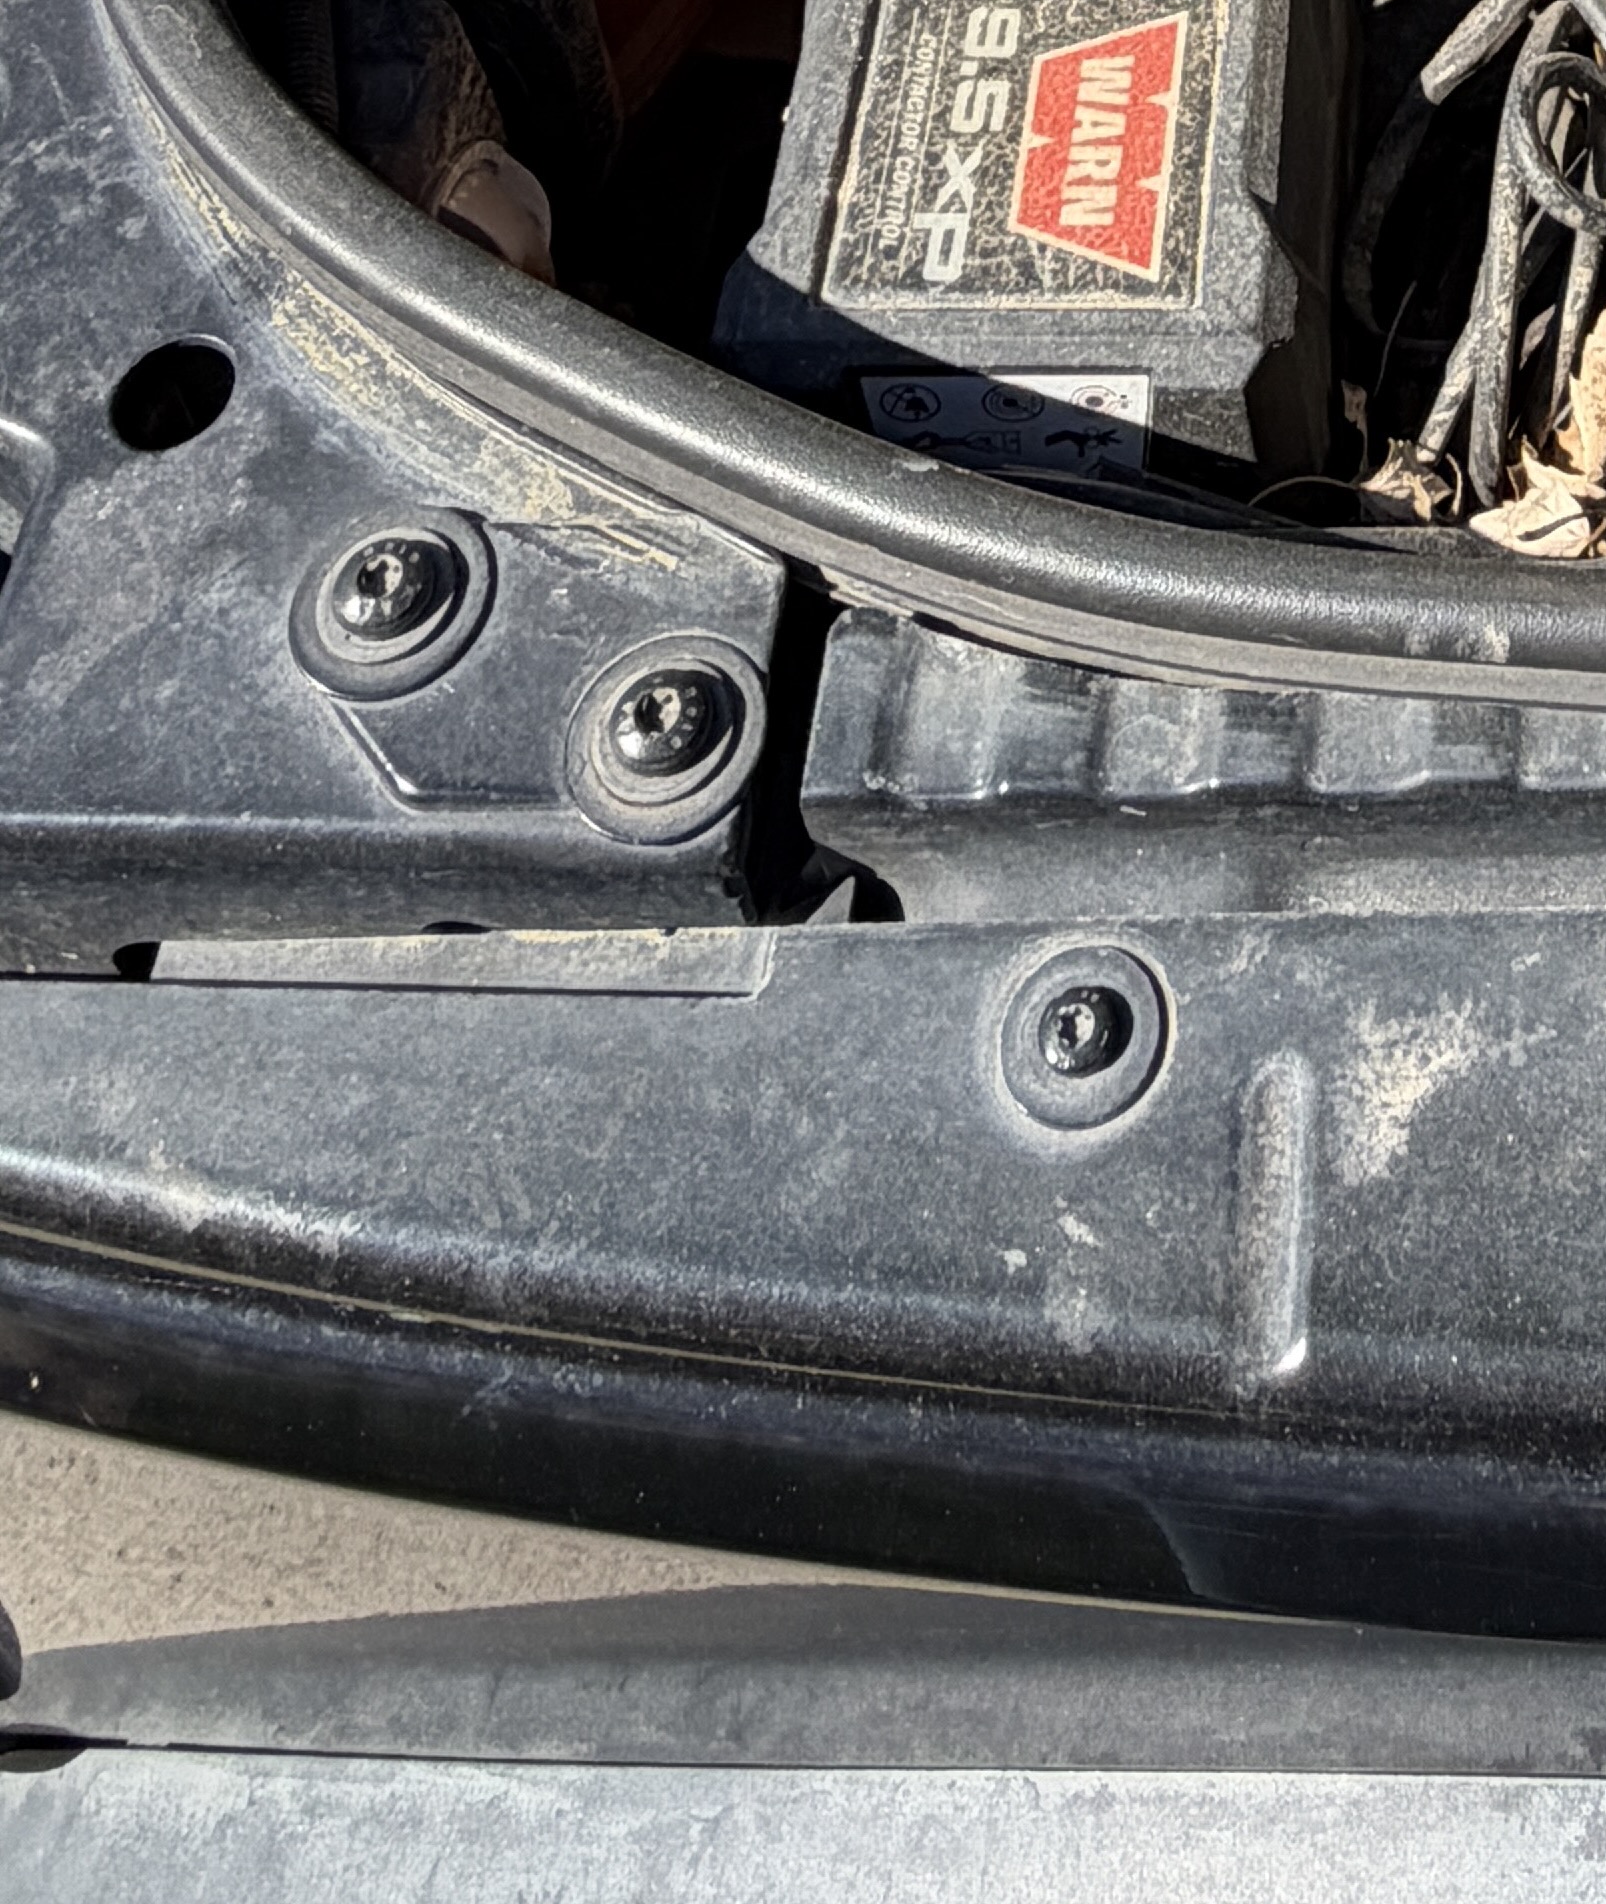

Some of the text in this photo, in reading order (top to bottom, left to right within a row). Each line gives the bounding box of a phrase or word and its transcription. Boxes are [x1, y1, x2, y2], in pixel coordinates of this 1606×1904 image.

[878, 33, 937, 250] CONTACTOR CONTROL
[1058, 55, 1136, 226] WARN
